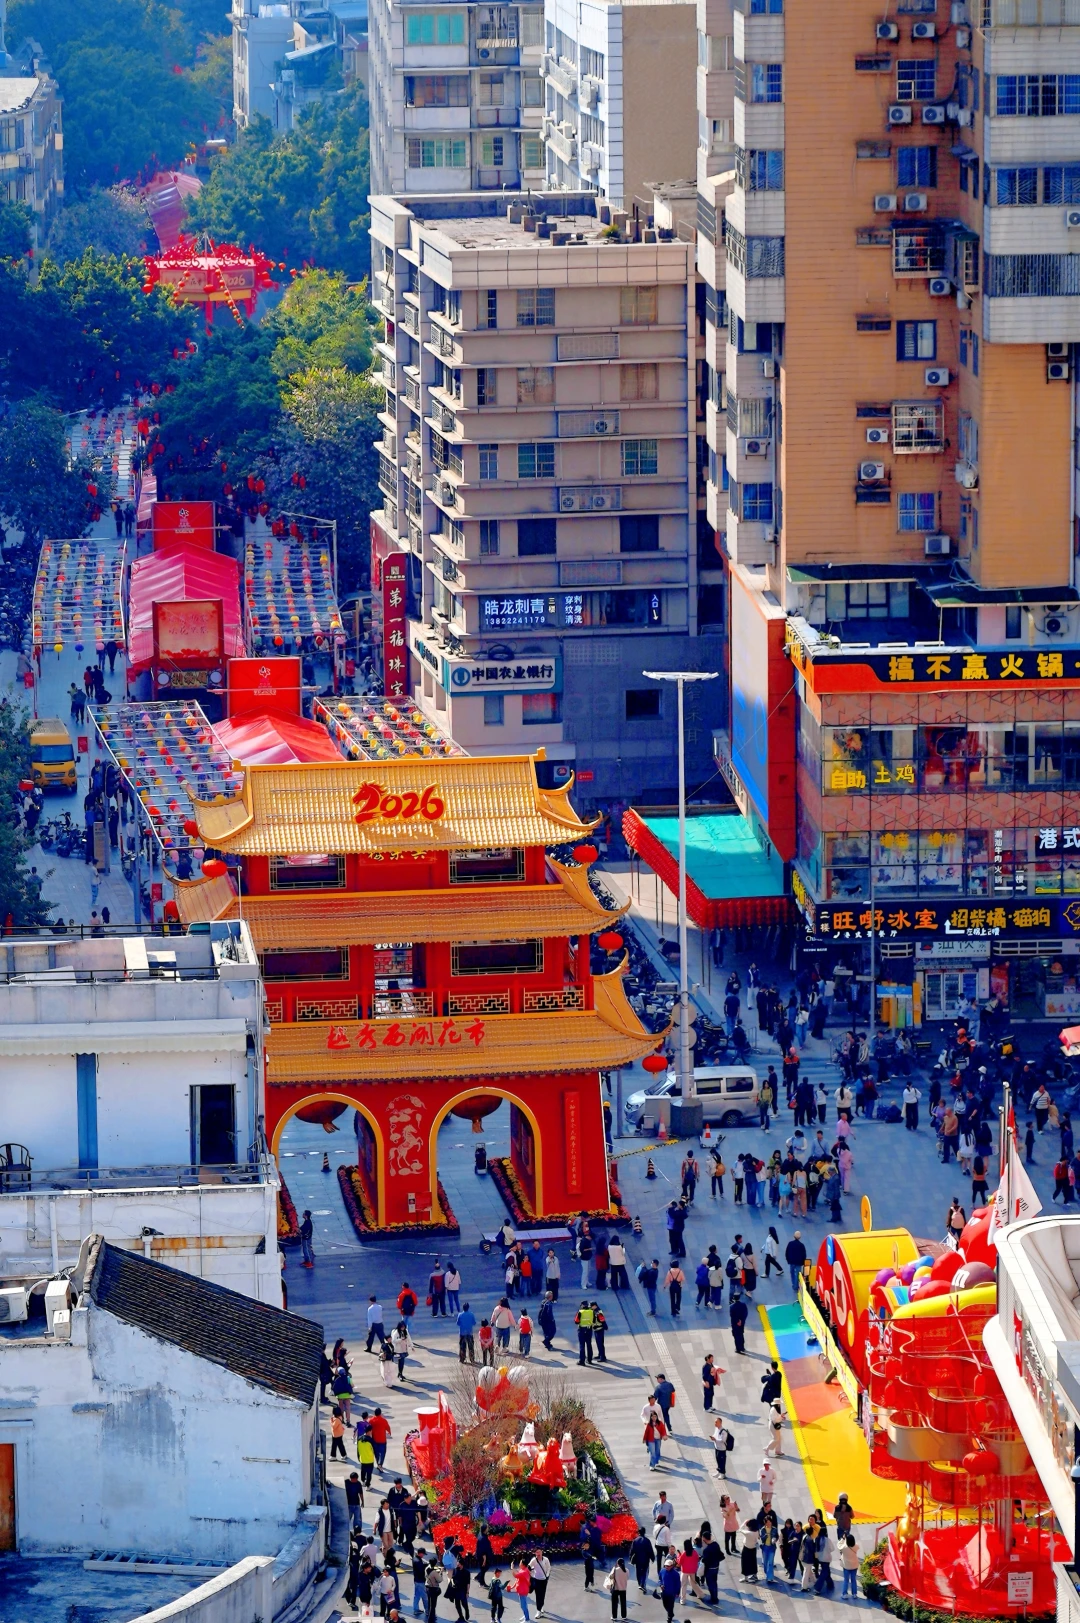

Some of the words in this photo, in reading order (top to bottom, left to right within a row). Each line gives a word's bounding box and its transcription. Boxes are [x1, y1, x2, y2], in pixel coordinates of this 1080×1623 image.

[484, 598, 545, 616] 皓龙刺青
[564, 594, 583, 605] 穿刺
[651, 594, 659, 608] 入口
[564, 604, 583, 615] 纹身
[485, 616, 546, 625] 13822241179
[564, 614, 583, 625] 清洗
[472, 664, 554, 682] 中国农业银行
[831, 769, 866, 789] 自助
[874, 764, 915, 784] 土鸡
[352, 780, 445, 824] 2026
[1039, 827, 1080, 850] 港式
